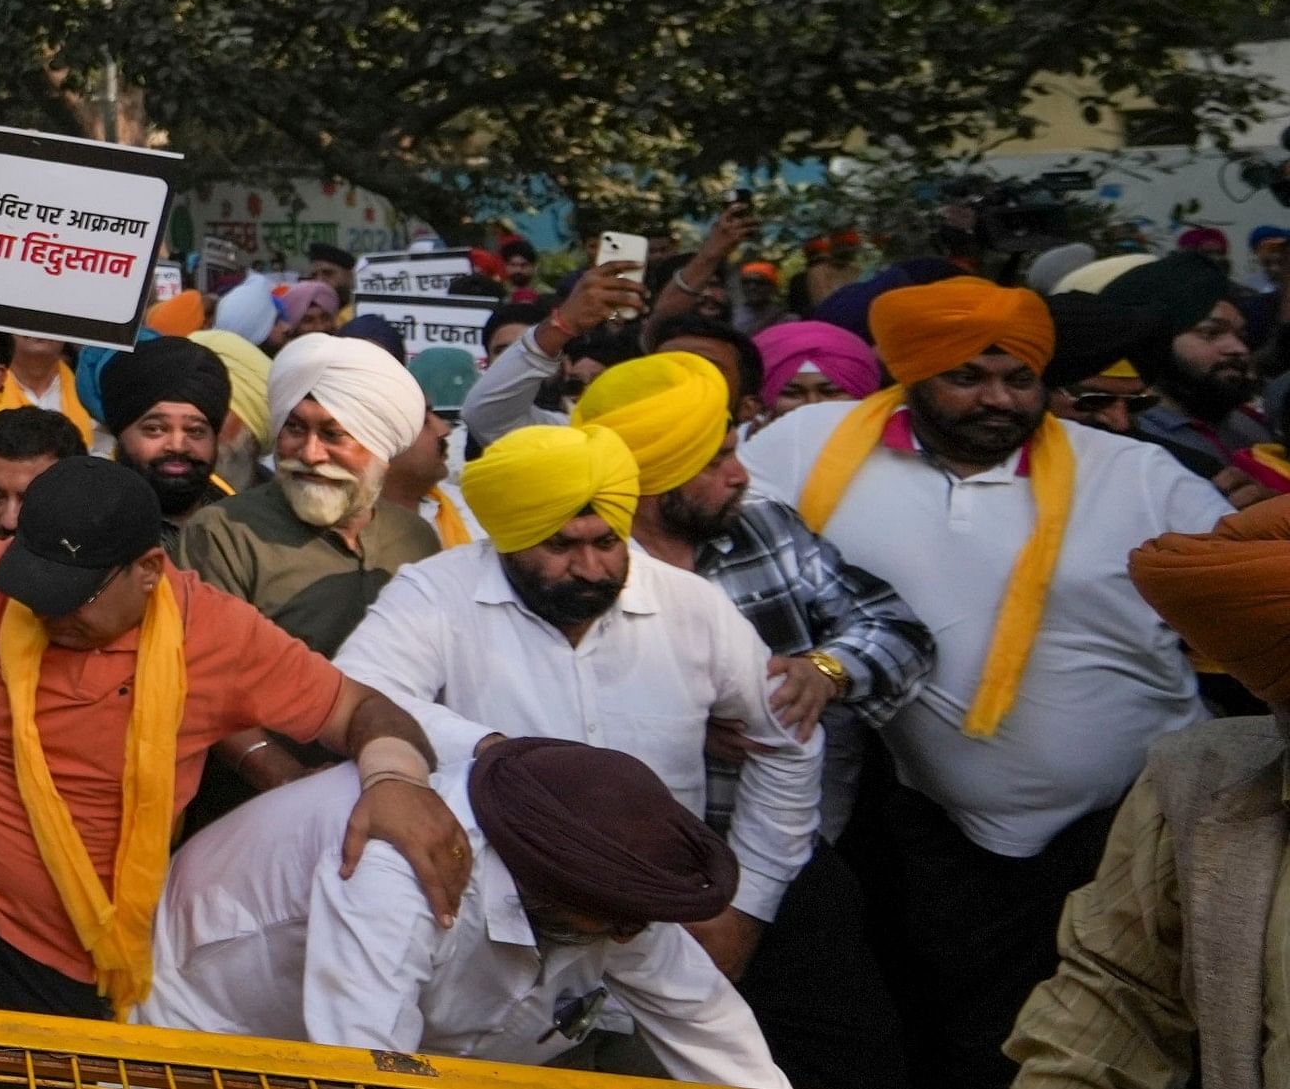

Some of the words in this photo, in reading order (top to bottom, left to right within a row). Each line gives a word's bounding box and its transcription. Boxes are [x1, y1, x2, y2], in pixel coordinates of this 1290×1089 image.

[33, 204, 65, 225] पर
[67, 209, 150, 238] आक्रमण
[20, 231, 137, 278] हिंदुस्तान
[423, 322, 485, 345] एकत
